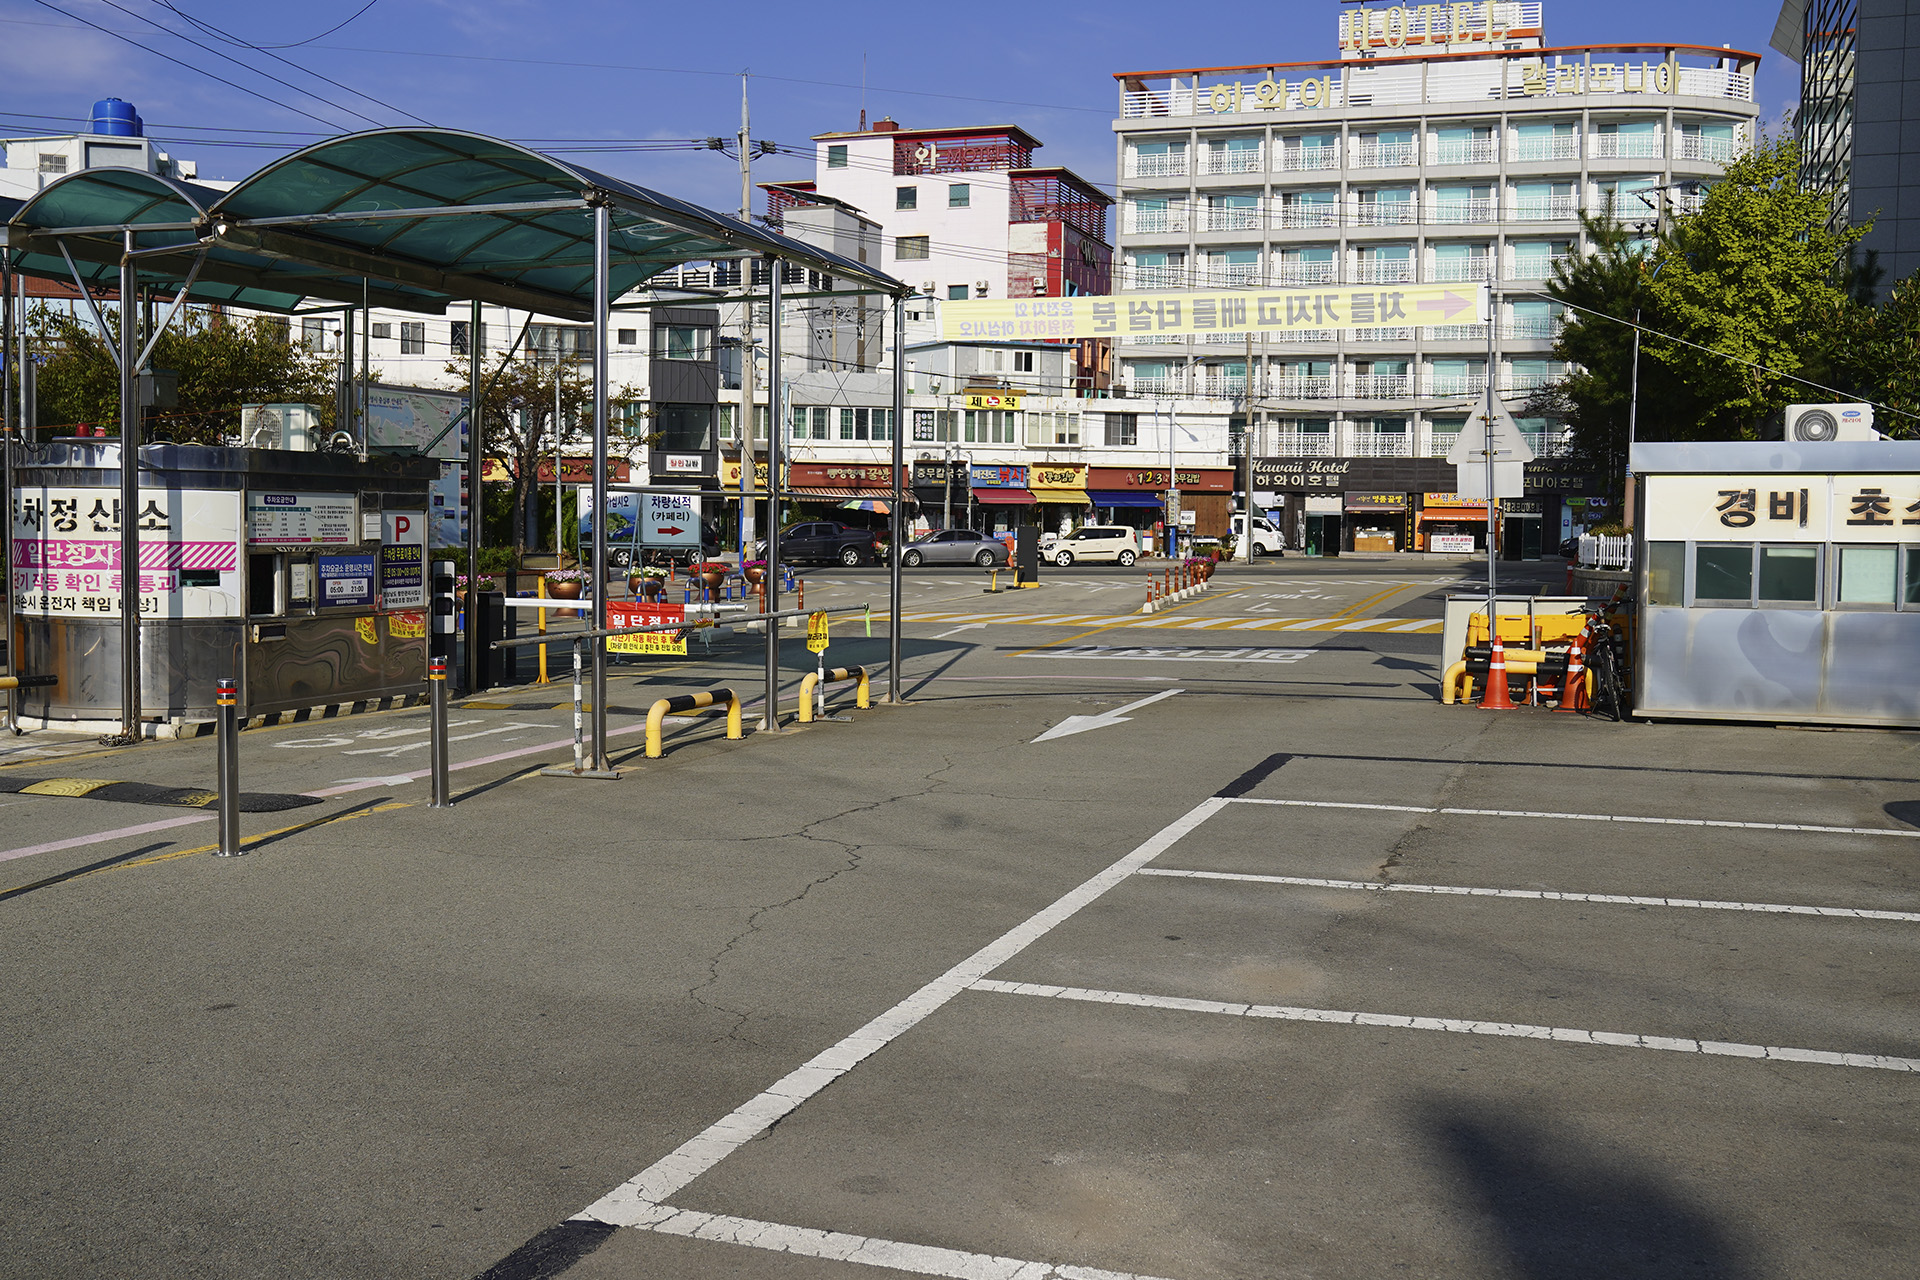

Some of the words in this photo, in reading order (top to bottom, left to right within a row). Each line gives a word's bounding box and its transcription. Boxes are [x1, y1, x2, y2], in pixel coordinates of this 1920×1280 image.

[1344, 0, 1507, 51] HOTEL
[1522, 61, 1682, 97] 캘리포니아
[1209, 75, 1332, 115] 하와이
[947, 146, 1004, 164] MOTEL
[972, 469, 997, 480] 비진도
[999, 467, 1024, 482] 낚시
[1252, 460, 1303, 474] Hawaii
[1306, 460, 1350, 474] Hotel
[1256, 474, 1340, 487] 하와이호텔
[651, 496, 691, 509] 차량선적
[1716, 488, 1808, 528] 경비
[14, 498, 172, 533] 차정산소
[651, 511, 691, 522] (카페리)
[396, 516, 411, 542] P
[28, 542, 114, 568] 일단정지
[32, 572, 59, 592] 작동
[65, 573, 100, 593] 확인
[330, 586, 344, 594] 05:00
[351, 585, 365, 593] 21:00
[39, 595, 77, 611] 운전자
[81, 597, 111, 612] 책임
